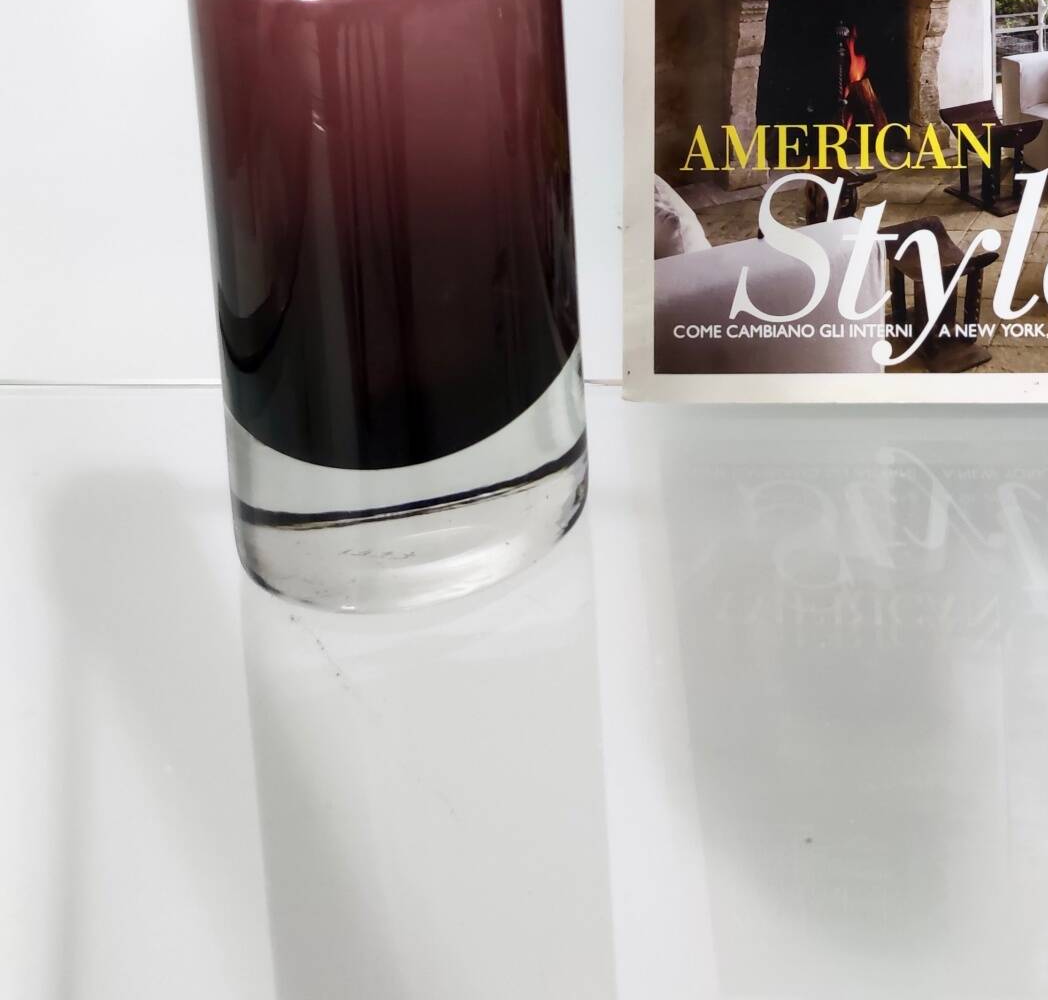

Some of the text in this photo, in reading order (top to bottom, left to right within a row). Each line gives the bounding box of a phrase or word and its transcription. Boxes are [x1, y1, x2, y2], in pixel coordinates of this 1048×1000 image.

[679, 123, 996, 171] AMERICAN
[673, 324, 722, 338] COME
[726, 324, 815, 338] CAMBIANO
[819, 324, 844, 338] GLI
[850, 324, 912, 338] INTERNI
[938, 325, 951, 338] A
[955, 325, 995, 338] NEW
